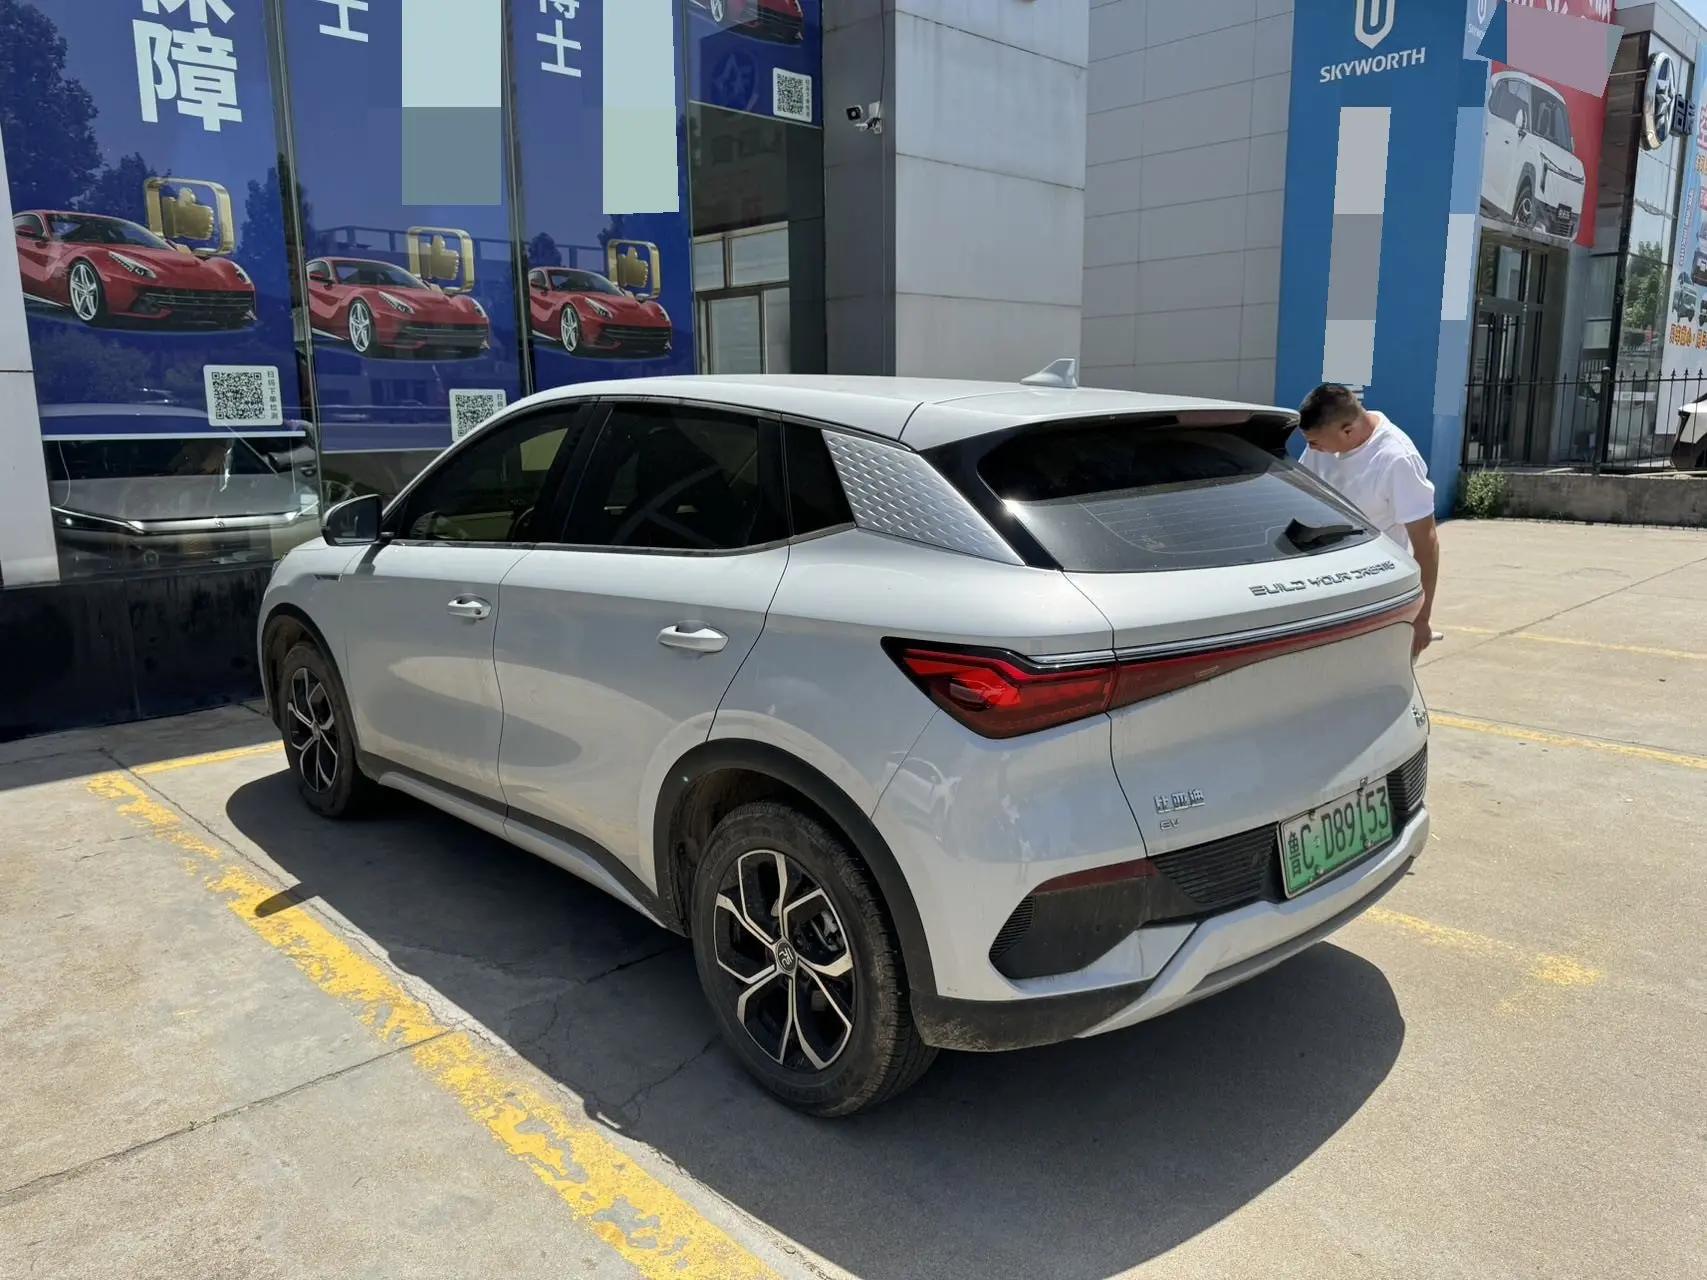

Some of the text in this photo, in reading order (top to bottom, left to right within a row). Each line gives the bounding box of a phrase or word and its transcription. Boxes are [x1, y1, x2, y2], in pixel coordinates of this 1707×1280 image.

[132, 0, 243, 133] 障
[1319, 47, 1426, 83] SKYWORTH
[1249, 580, 1306, 597] BUILD
[1307, 572, 1351, 588] YOUR
[1153, 788, 1205, 814] 比亚迪
[1160, 818, 1180, 831] EV
